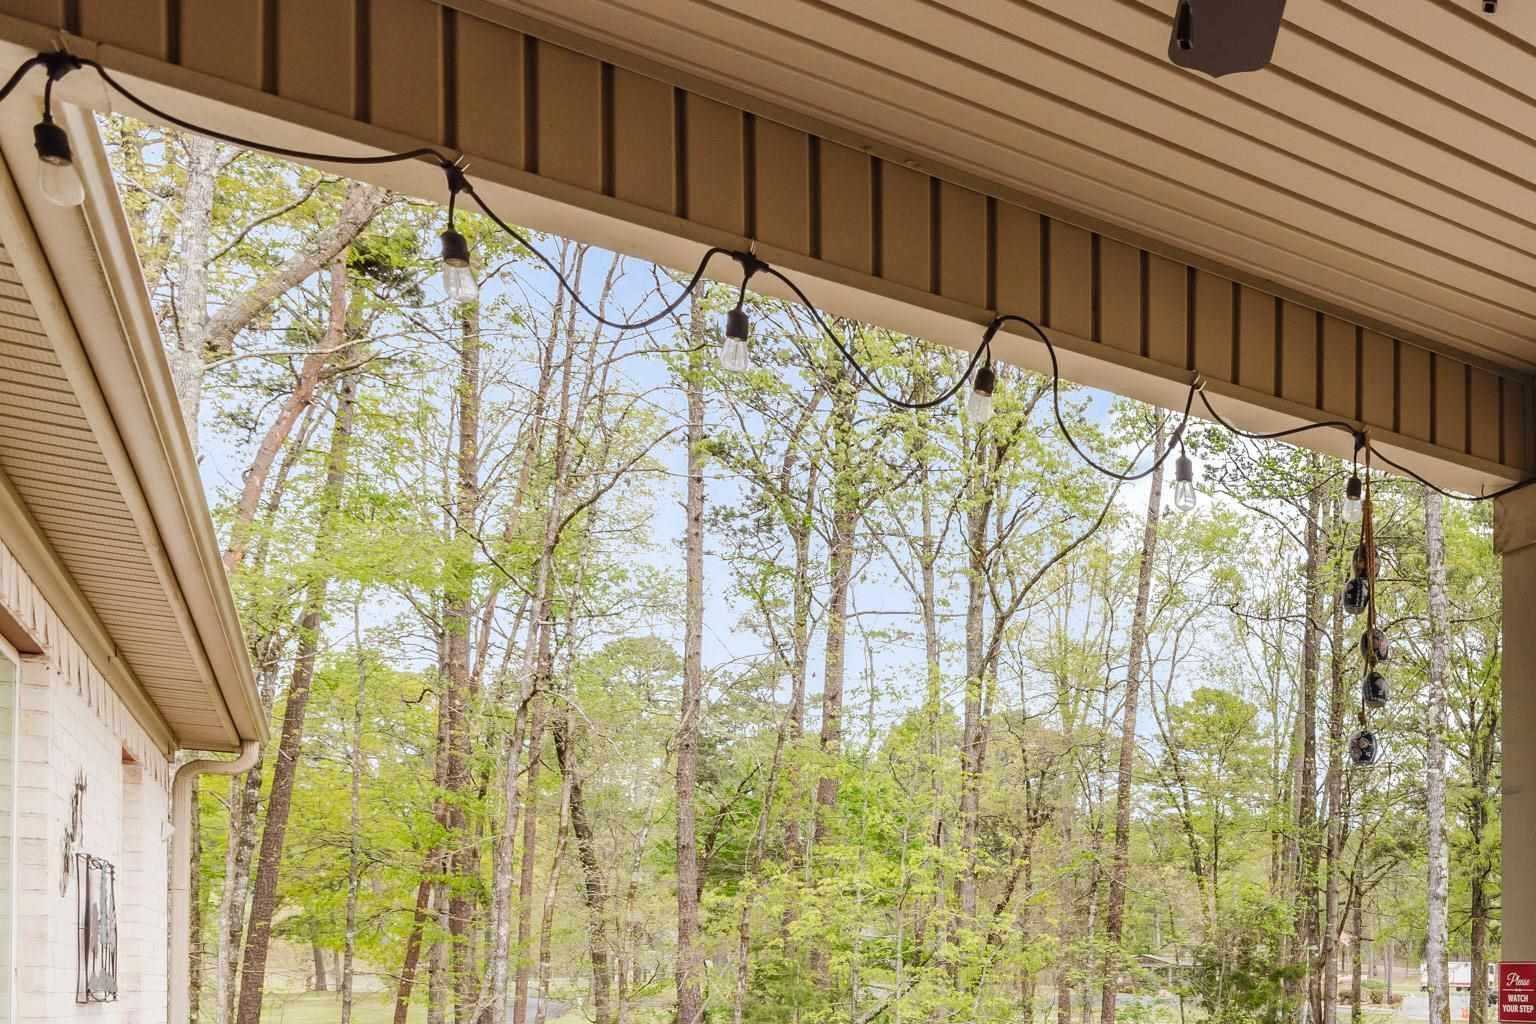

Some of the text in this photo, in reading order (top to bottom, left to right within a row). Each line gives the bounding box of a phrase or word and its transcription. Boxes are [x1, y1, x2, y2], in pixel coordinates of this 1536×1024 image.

[1506, 972, 1530, 986] Please
[1508, 994, 1528, 1002] WATCH
[1503, 1005, 1534, 1013] YOUR STEP
